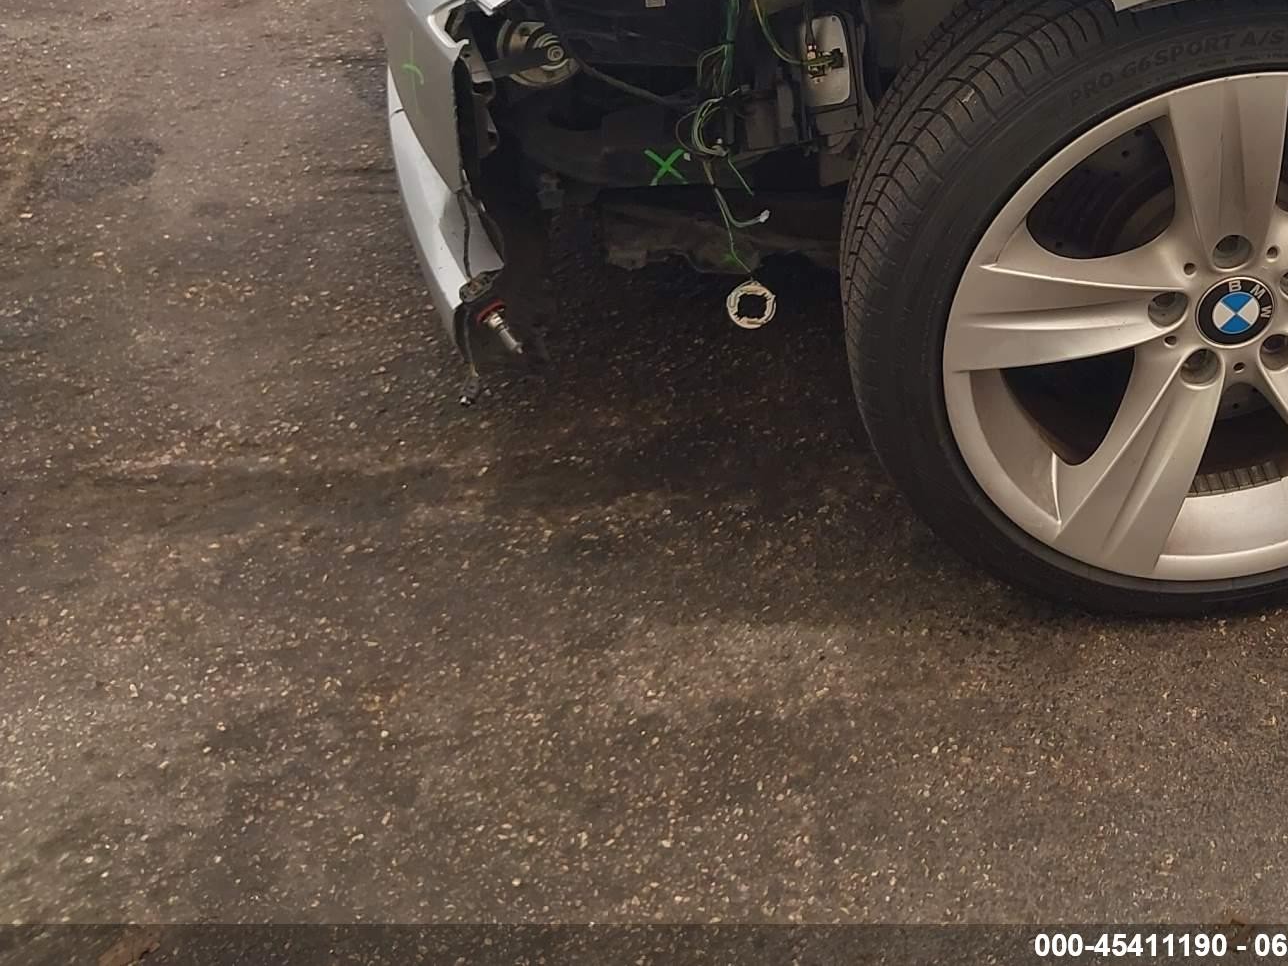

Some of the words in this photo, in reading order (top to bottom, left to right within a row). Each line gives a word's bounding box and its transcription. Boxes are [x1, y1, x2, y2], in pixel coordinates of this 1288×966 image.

[1070, 71, 1114, 104] PRO
[1239, 28, 1287, 49] A/S
[1228, 280, 1272, 318] BMW
